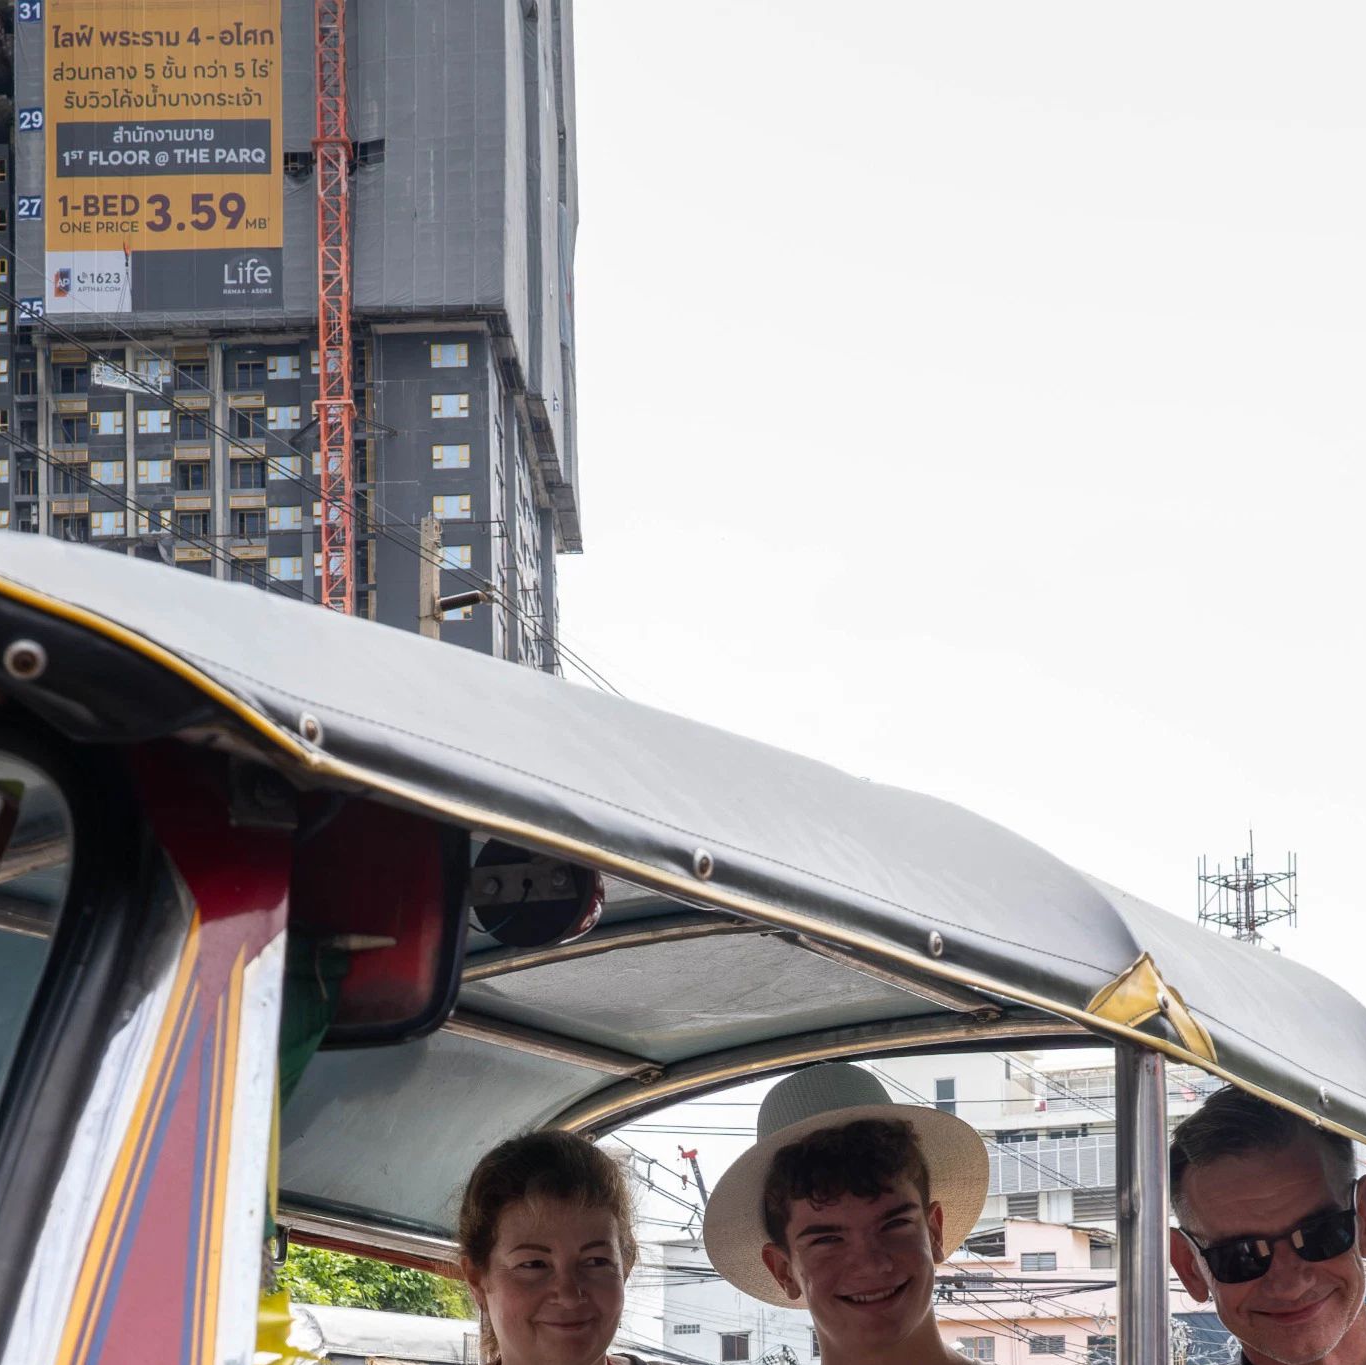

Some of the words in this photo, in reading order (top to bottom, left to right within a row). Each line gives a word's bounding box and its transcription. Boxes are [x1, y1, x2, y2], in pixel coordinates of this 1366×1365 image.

[19, 3, 42, 20] 31
[52, 24, 94, 48] ไลฟ์
[100, 29, 180, 47] พระราม
[187, 27, 201, 46] 4
[219, 22, 274, 46] อโศก
[52, 61, 137, 82] ส่วนกลาง
[144, 63, 155, 80] 5
[162, 56, 186, 79] ชั้น
[194, 60, 227, 79] กว่า
[234, 62, 245, 78] 5
[64, 84, 262, 110] รับวิวโค้งน้ำบางกระเจ้า
[19, 110, 43, 130] 29
[112, 126, 215, 144] สำนักงานขาย
[62, 150, 84, 166] 1ST
[88, 150, 150, 166] FLOOR
[154, 151, 169, 166] @
[174, 149, 210, 164] THE
[215, 148, 267, 164] PARQ
[18, 199, 41, 215] 27
[58, 194, 140, 217] 1-BED
[145, 192, 246, 232] 3.59
[59, 221, 92, 234] ONE
[96, 220, 139, 234] PRICE
[89, 272, 122, 284] 1623
[223, 258, 272, 285] Life
[57, 278, 70, 288] AP
[19, 301, 43, 319] 25
